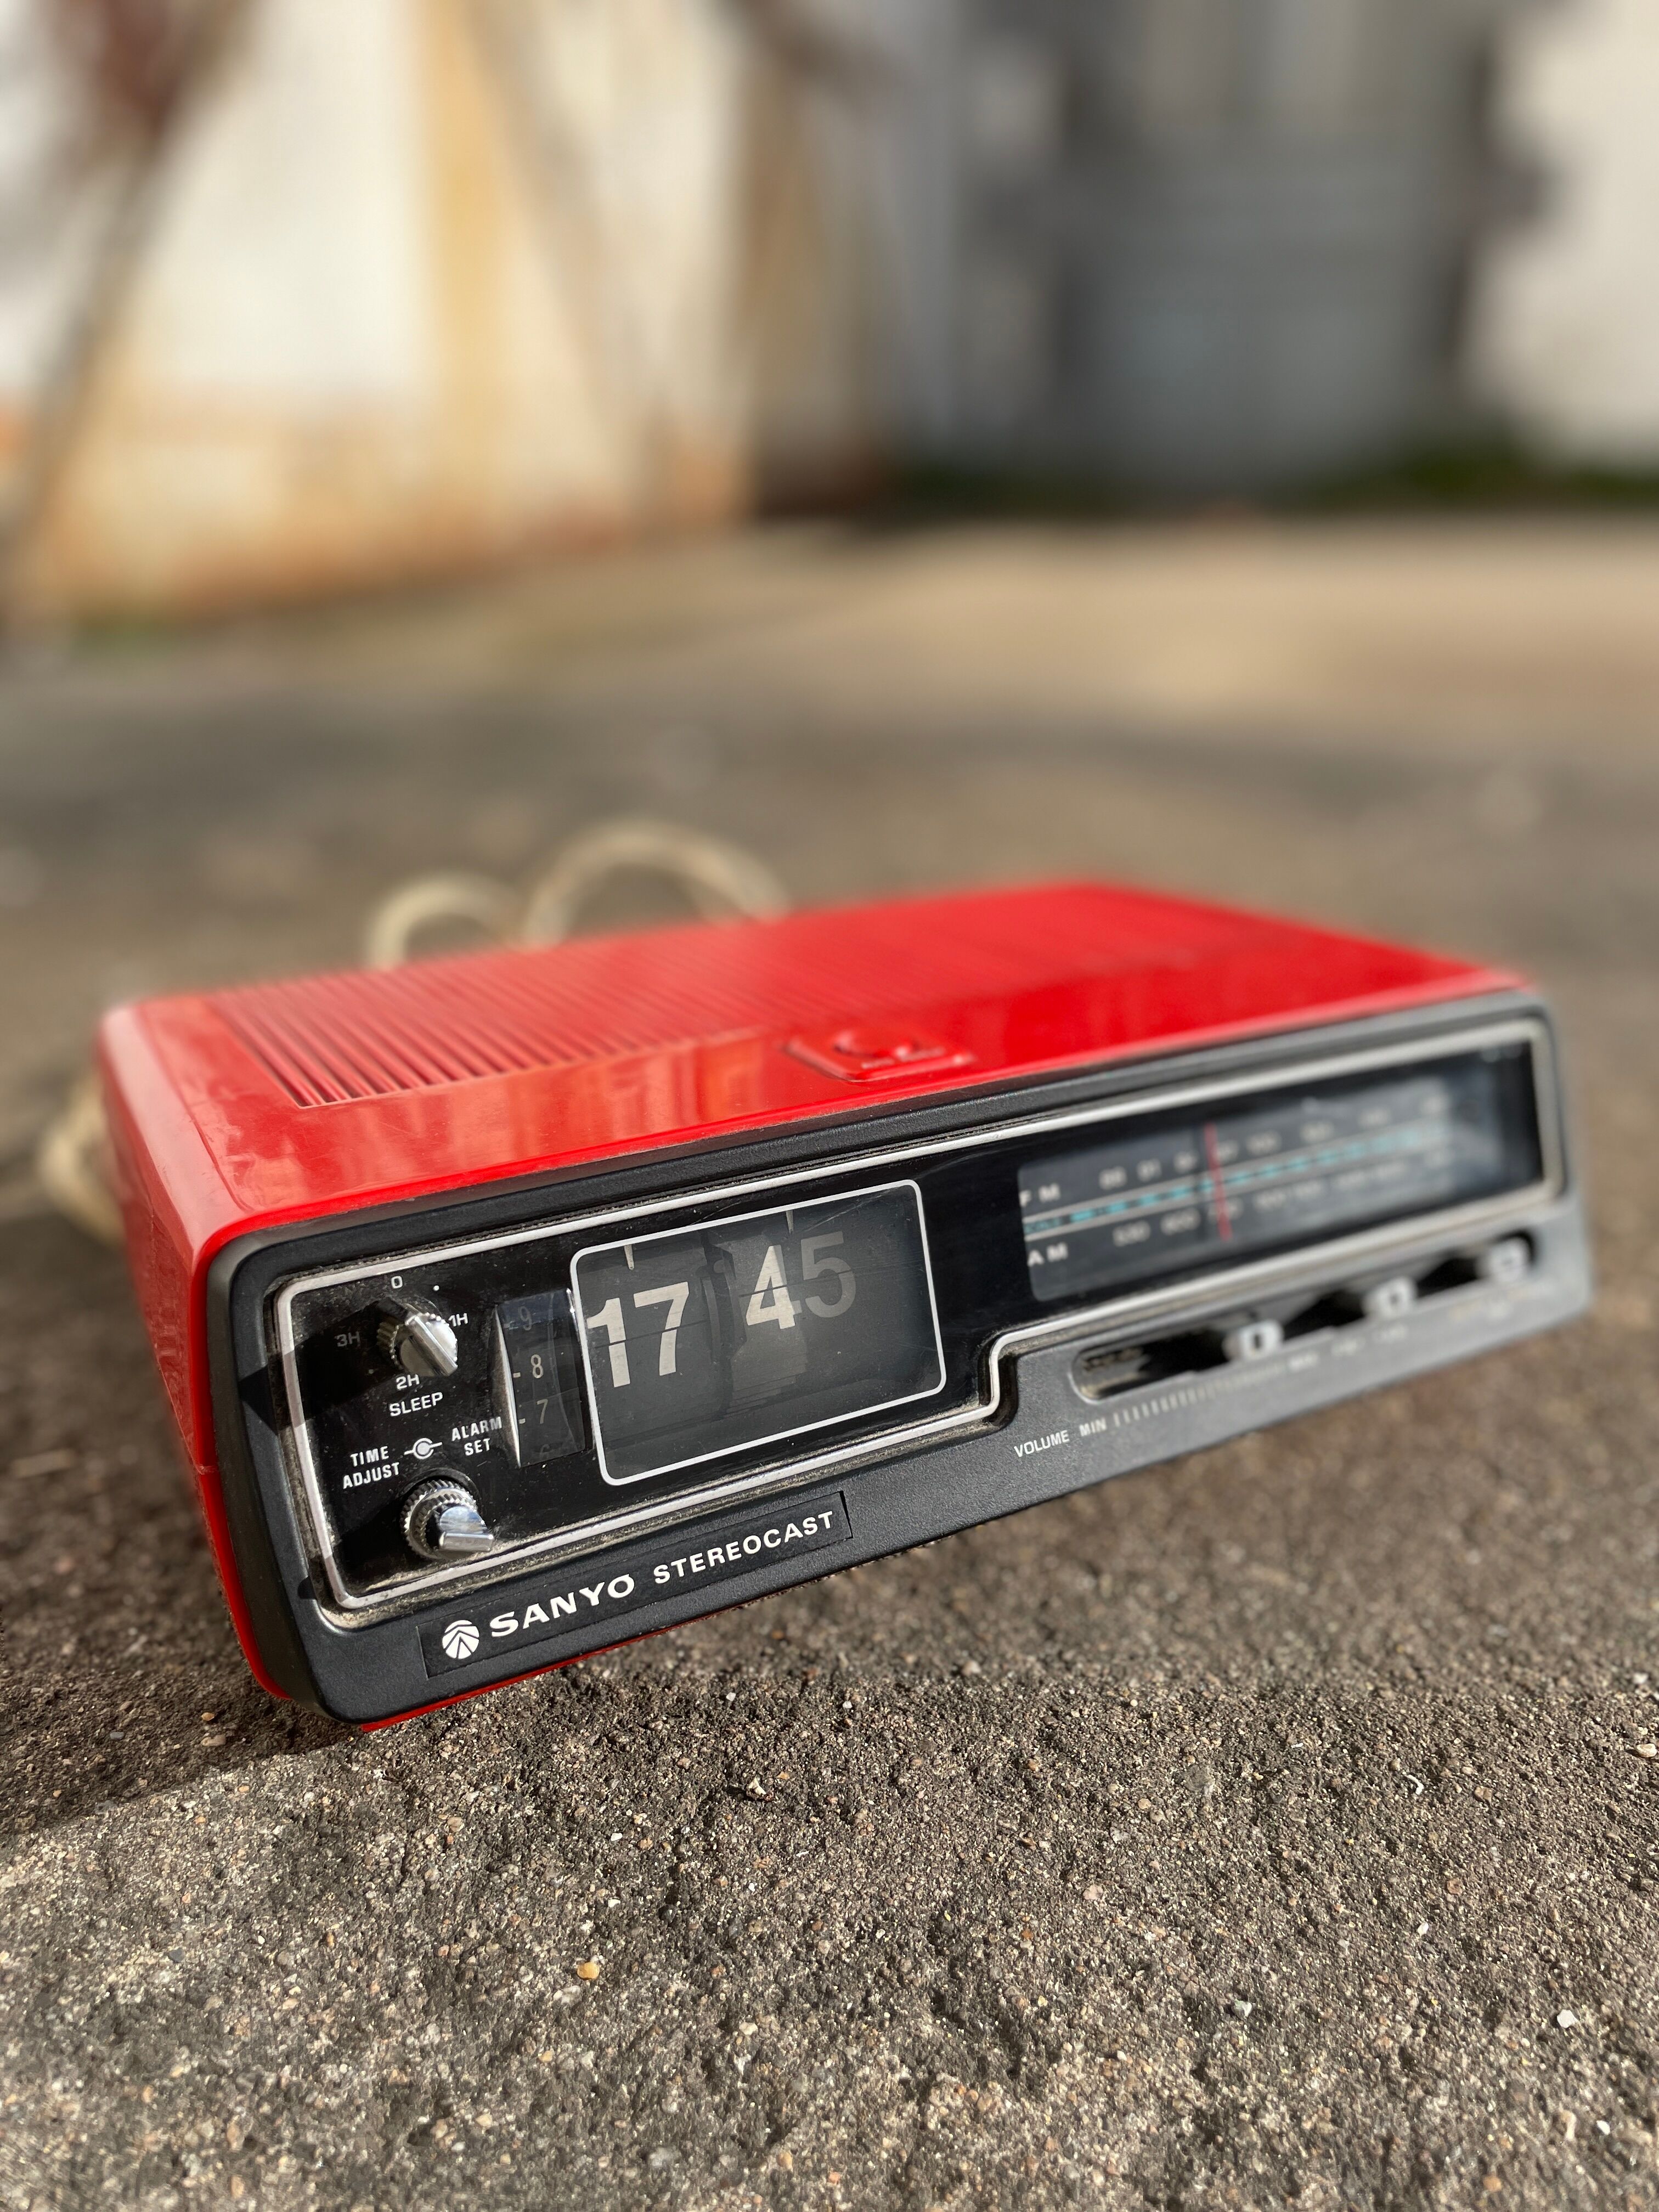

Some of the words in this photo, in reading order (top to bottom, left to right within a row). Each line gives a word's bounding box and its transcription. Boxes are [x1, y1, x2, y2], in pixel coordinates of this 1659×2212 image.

[1019, 1182, 1060, 1207] FM
[1028, 1242, 1068, 1267] AM
[448, 1313, 469, 1327] 1H
[586, 1282, 690, 1388] 17
[746, 1231, 856, 1330] 45
[334, 1331, 361, 1347] 3H
[531, 1354, 544, 1379] 8
[396, 1373, 420, 1390] 2H
[389, 1392, 443, 1417] SLEEP
[537, 1398, 549, 1424] 7
[451, 1416, 502, 1442] ALARM
[1013, 1430, 1070, 1458] VOLUME
[1079, 1417, 1107, 1437] MIN
[350, 1446, 390, 1467] TIME
[464, 1437, 490, 1457] SET
[342, 1462, 400, 1489] ADJUST
[490, 1573, 635, 1638] SANYO
[653, 1510, 834, 1584] STEREOCAST
